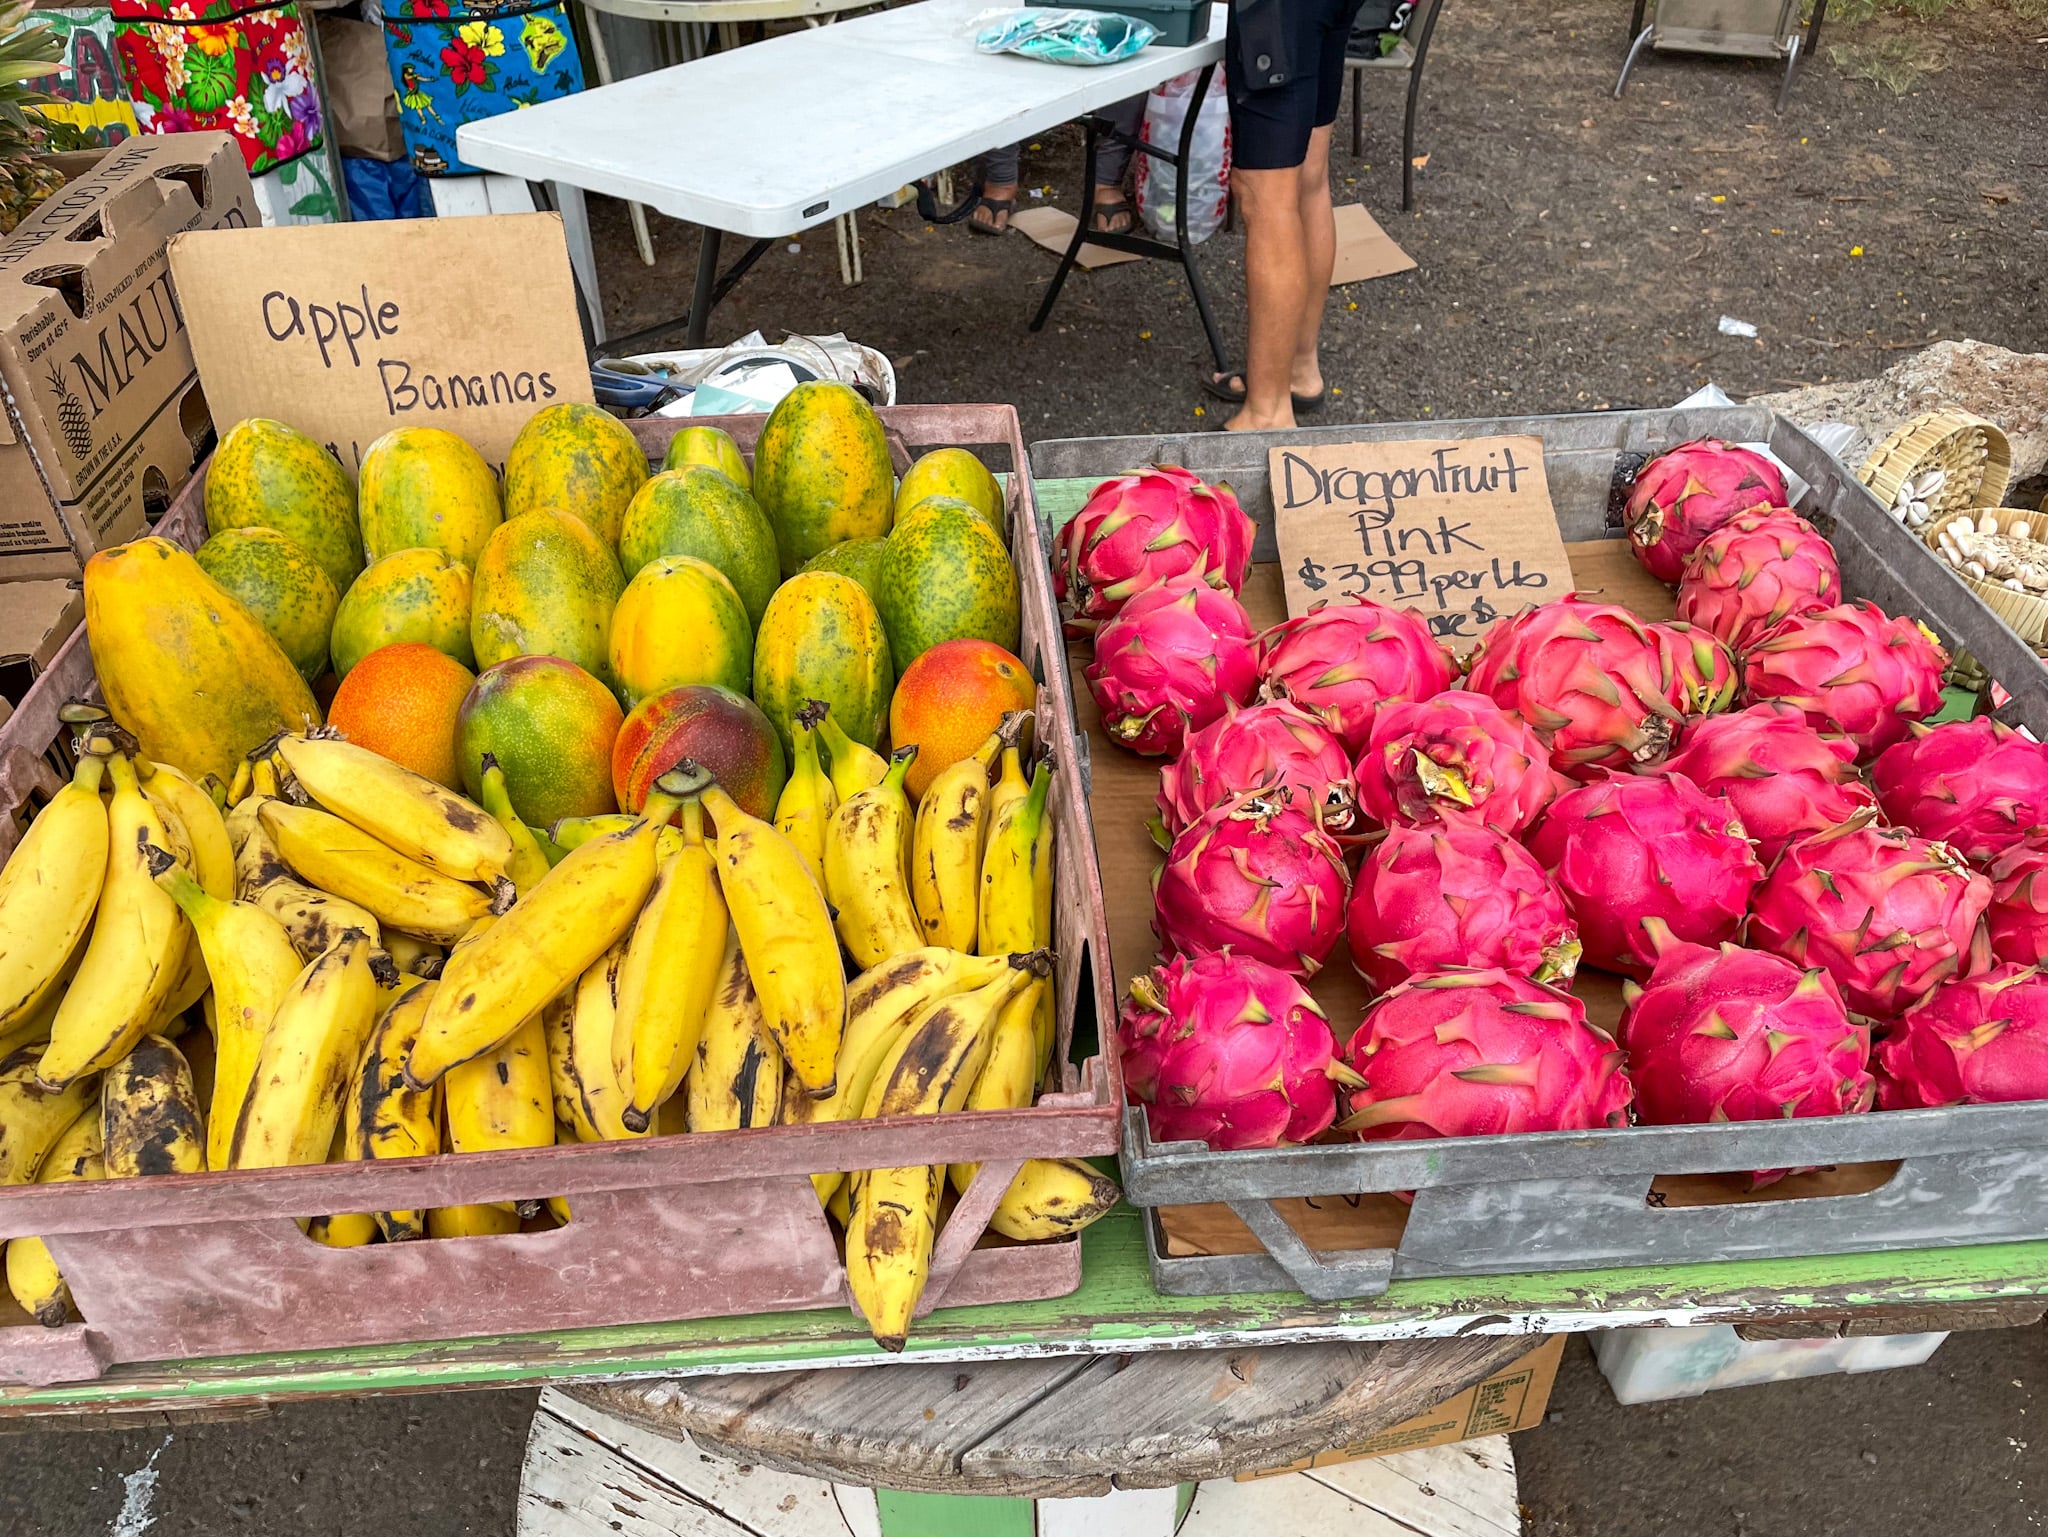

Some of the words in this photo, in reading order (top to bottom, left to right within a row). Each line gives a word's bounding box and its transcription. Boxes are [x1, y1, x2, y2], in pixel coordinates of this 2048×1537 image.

[93, 146, 160, 182] MAUI
[41, 185, 109, 225] GOLD
[0, 229, 61, 270] PINE
[96, 274, 133, 314] HAND-PICKED
[134, 260, 149, 279] RIPE
[20, 311, 57, 347] Perishable
[70, 269, 185, 420] MAUI
[262, 283, 399, 368] apple
[27, 342, 47, 363] Store
[46, 332, 55, 347] at
[377, 357, 558, 416] Bananas
[76, 460, 95, 487] GROWN
[92, 453, 101, 468] IN
[98, 444, 109, 462] THE
[1298, 557, 1429, 601] $3.99
